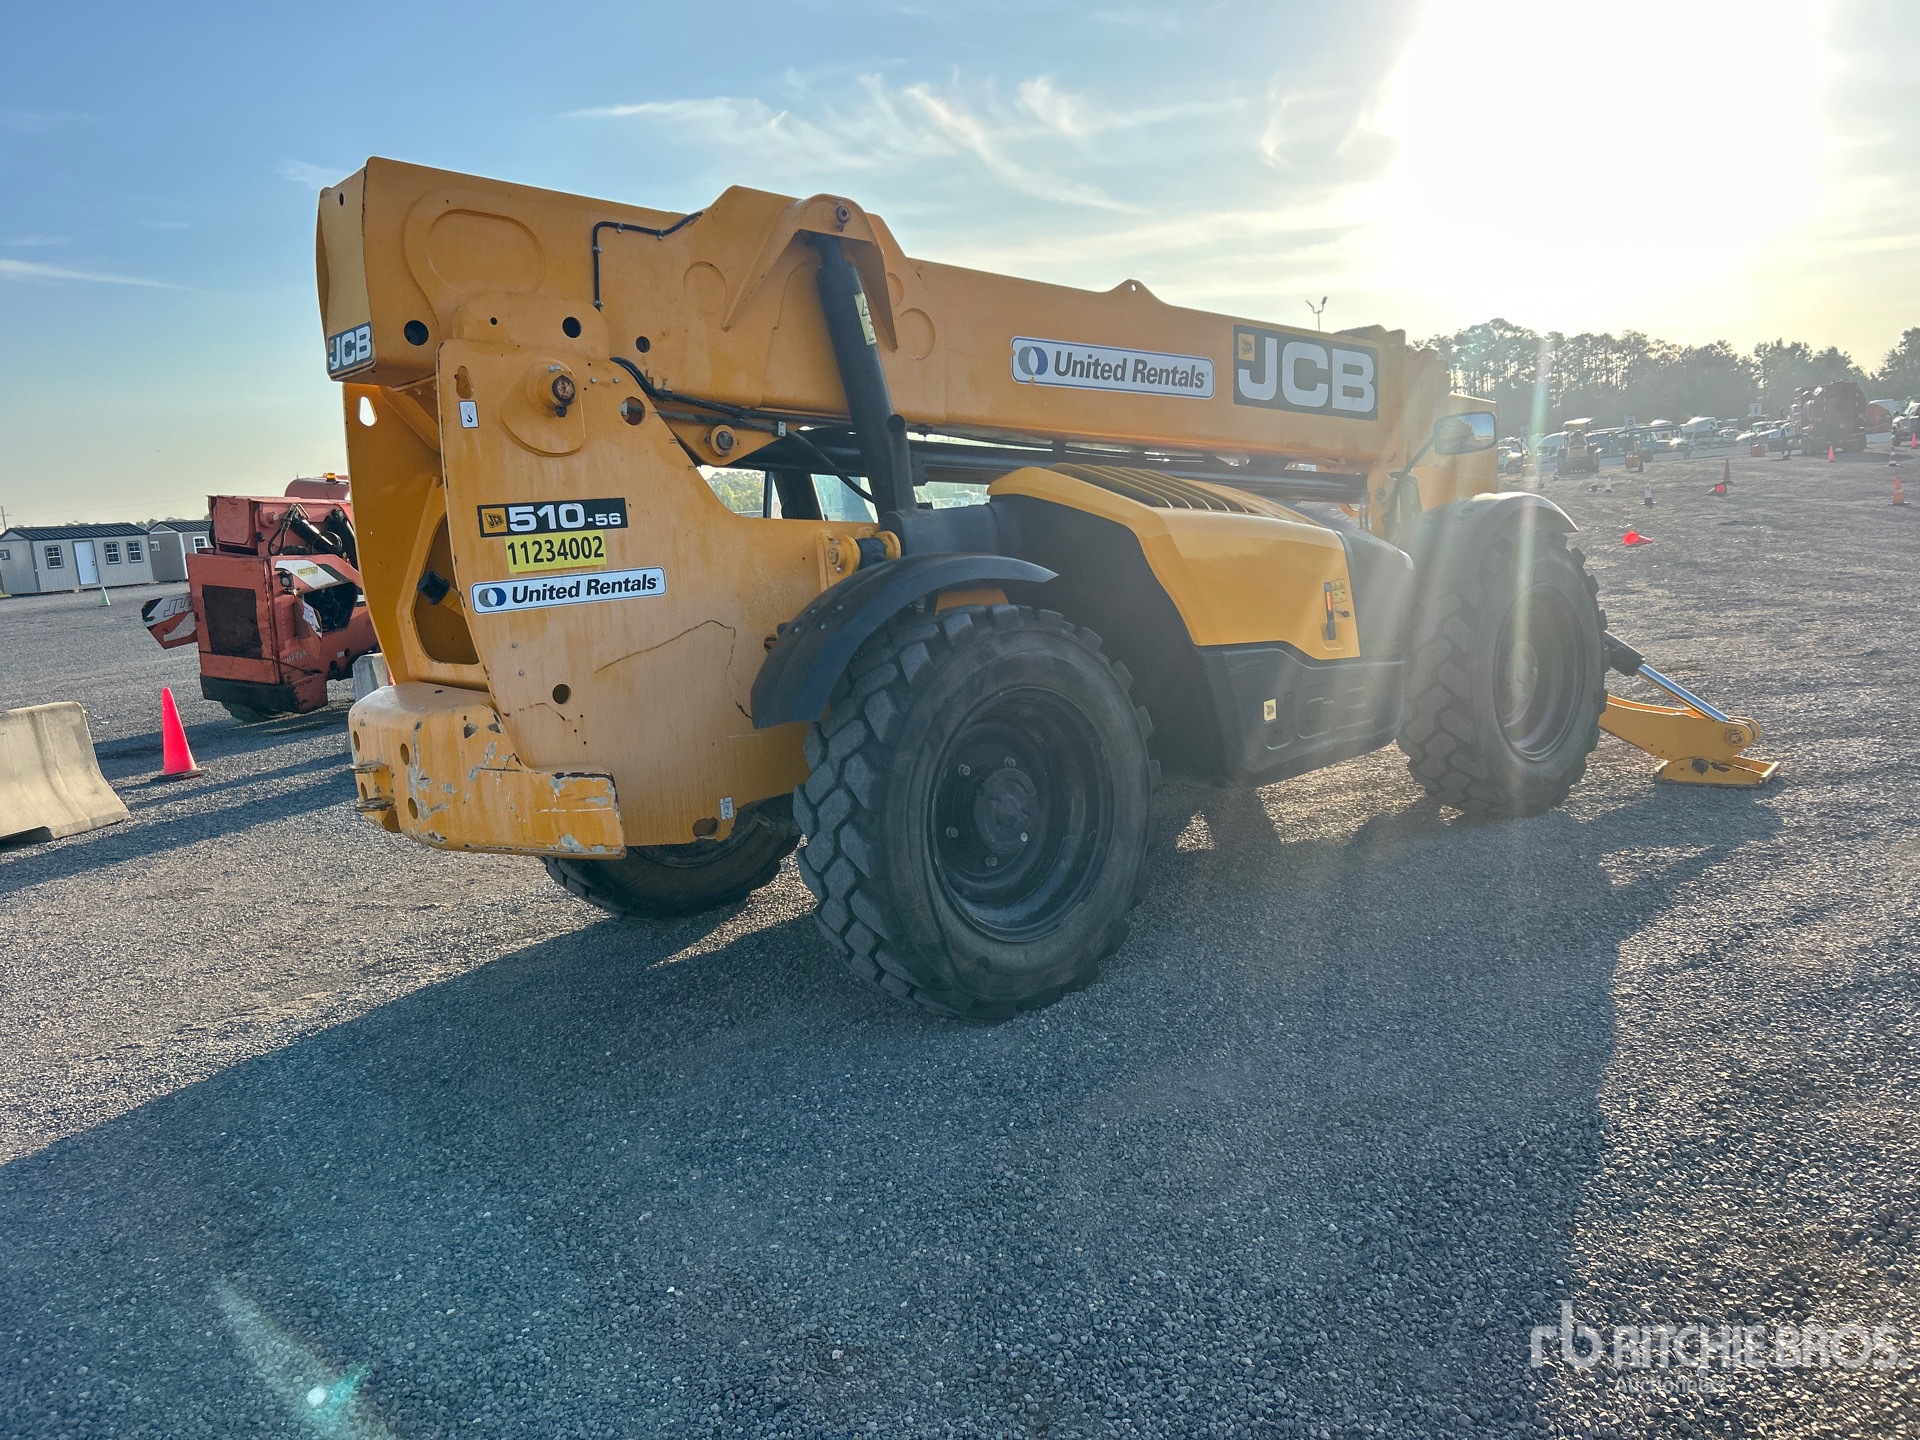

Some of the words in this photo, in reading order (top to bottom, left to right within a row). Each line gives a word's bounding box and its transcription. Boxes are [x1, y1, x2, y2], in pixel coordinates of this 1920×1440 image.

[329, 325, 371, 370] JCB
[1054, 350, 1127, 382] United
[1132, 357, 1206, 389] Rentals
[1238, 336, 1375, 413] JCB
[508, 502, 622, 532] 510-56
[507, 535, 604, 565] 11234002
[511, 580, 580, 604] United
[586, 573, 657, 596] Rentals
